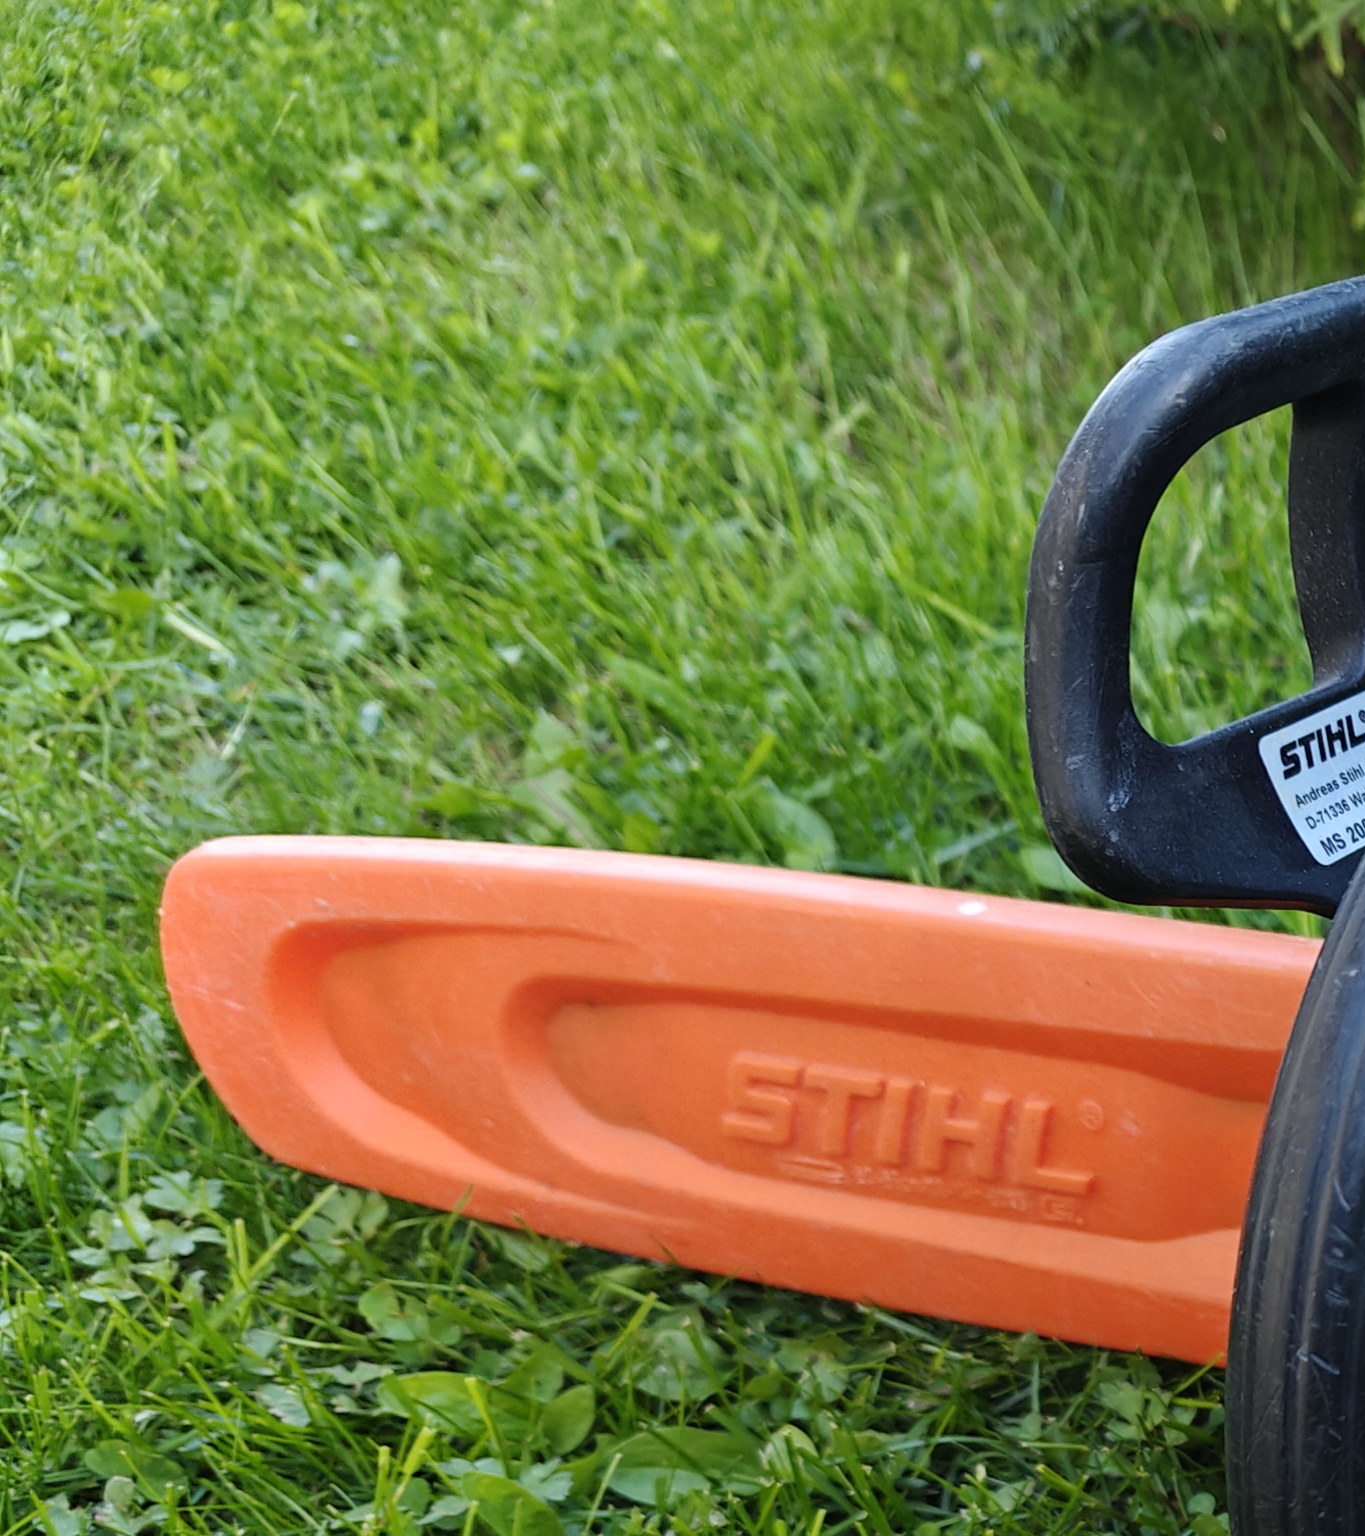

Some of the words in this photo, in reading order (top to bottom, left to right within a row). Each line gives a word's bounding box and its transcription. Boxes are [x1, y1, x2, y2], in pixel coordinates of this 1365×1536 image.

[1294, 779, 1340, 808] Andreas
[1339, 764, 1365, 785] Stihl
[1305, 799, 1350, 829] D-71336
[1320, 832, 1347, 857] MS
